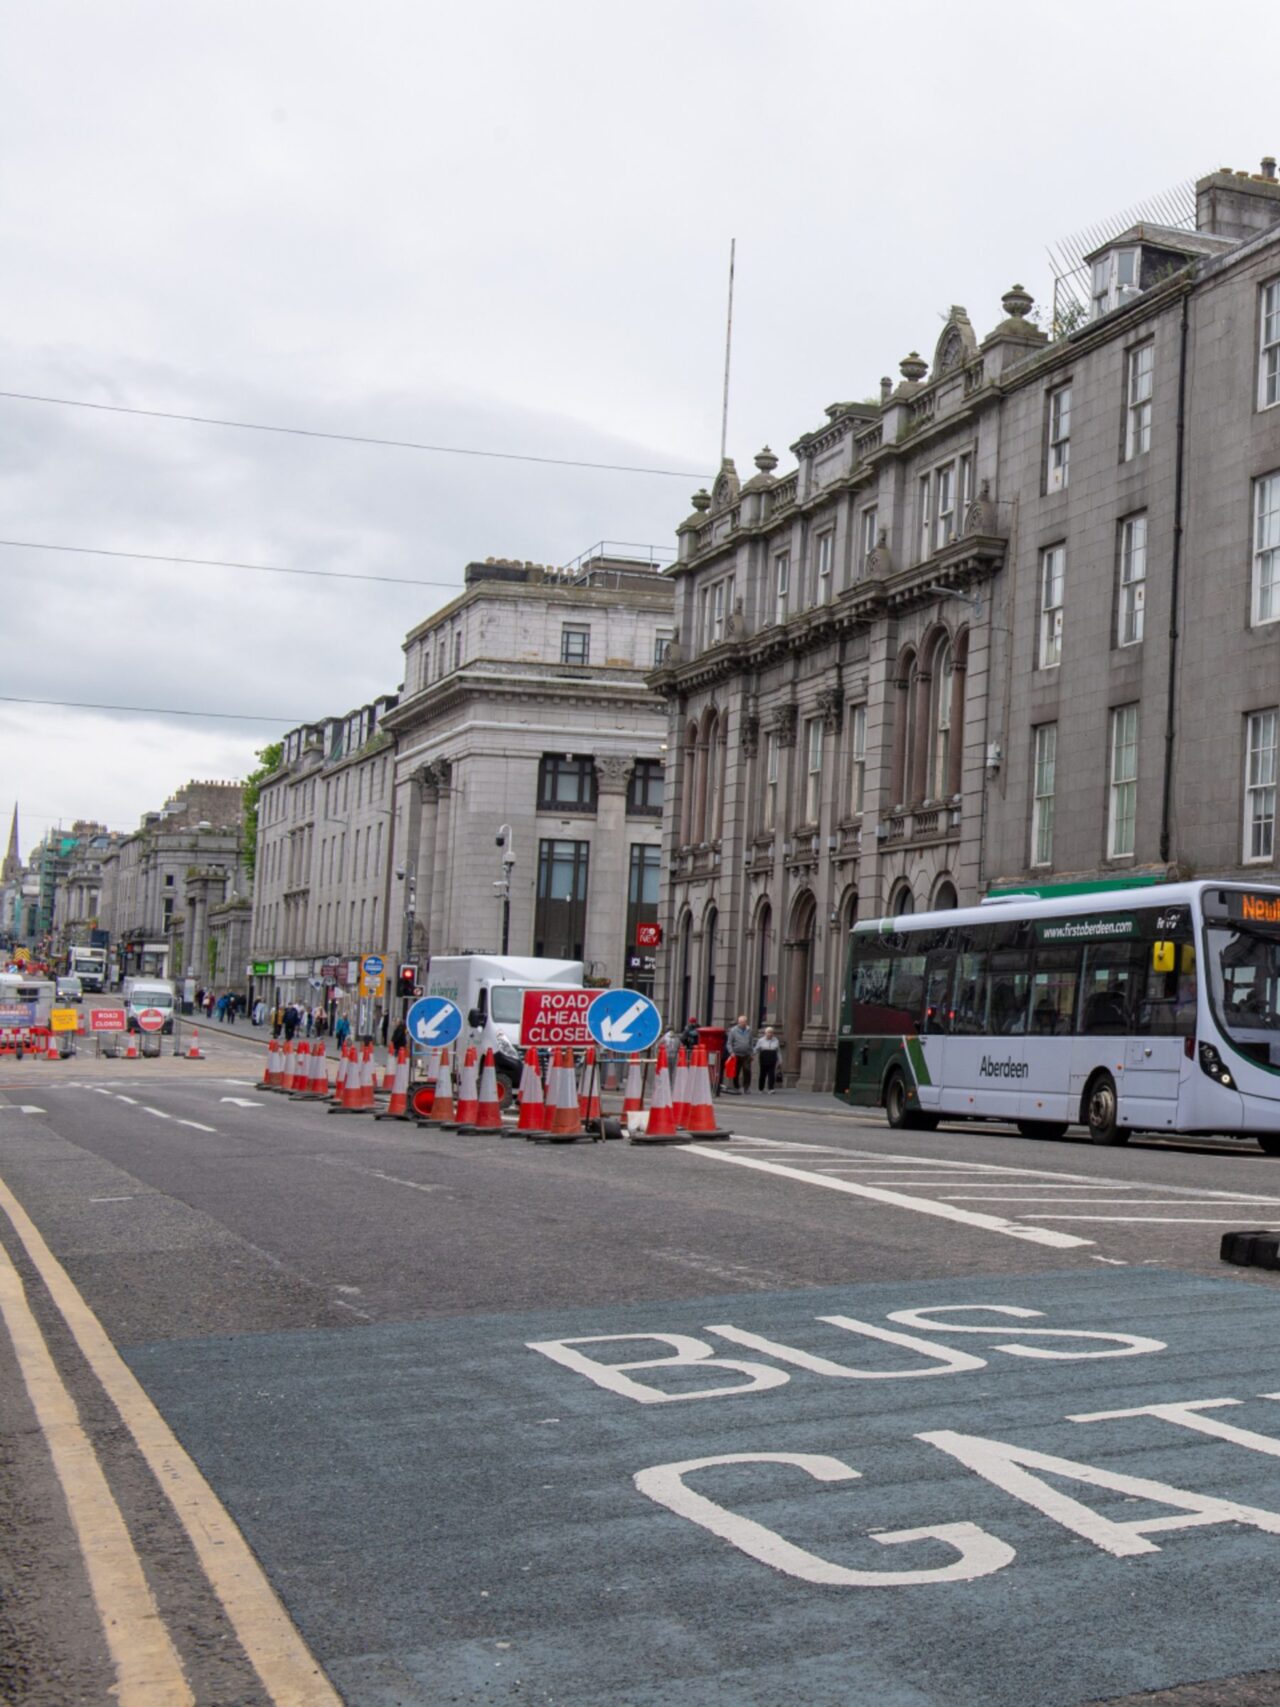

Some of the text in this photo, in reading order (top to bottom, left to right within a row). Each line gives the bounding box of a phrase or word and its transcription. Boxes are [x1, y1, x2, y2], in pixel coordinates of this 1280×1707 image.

[540, 994, 590, 1009] ROAD
[979, 1055, 1029, 1078] Aberdeen
[525, 1303, 1168, 1403] BUS
